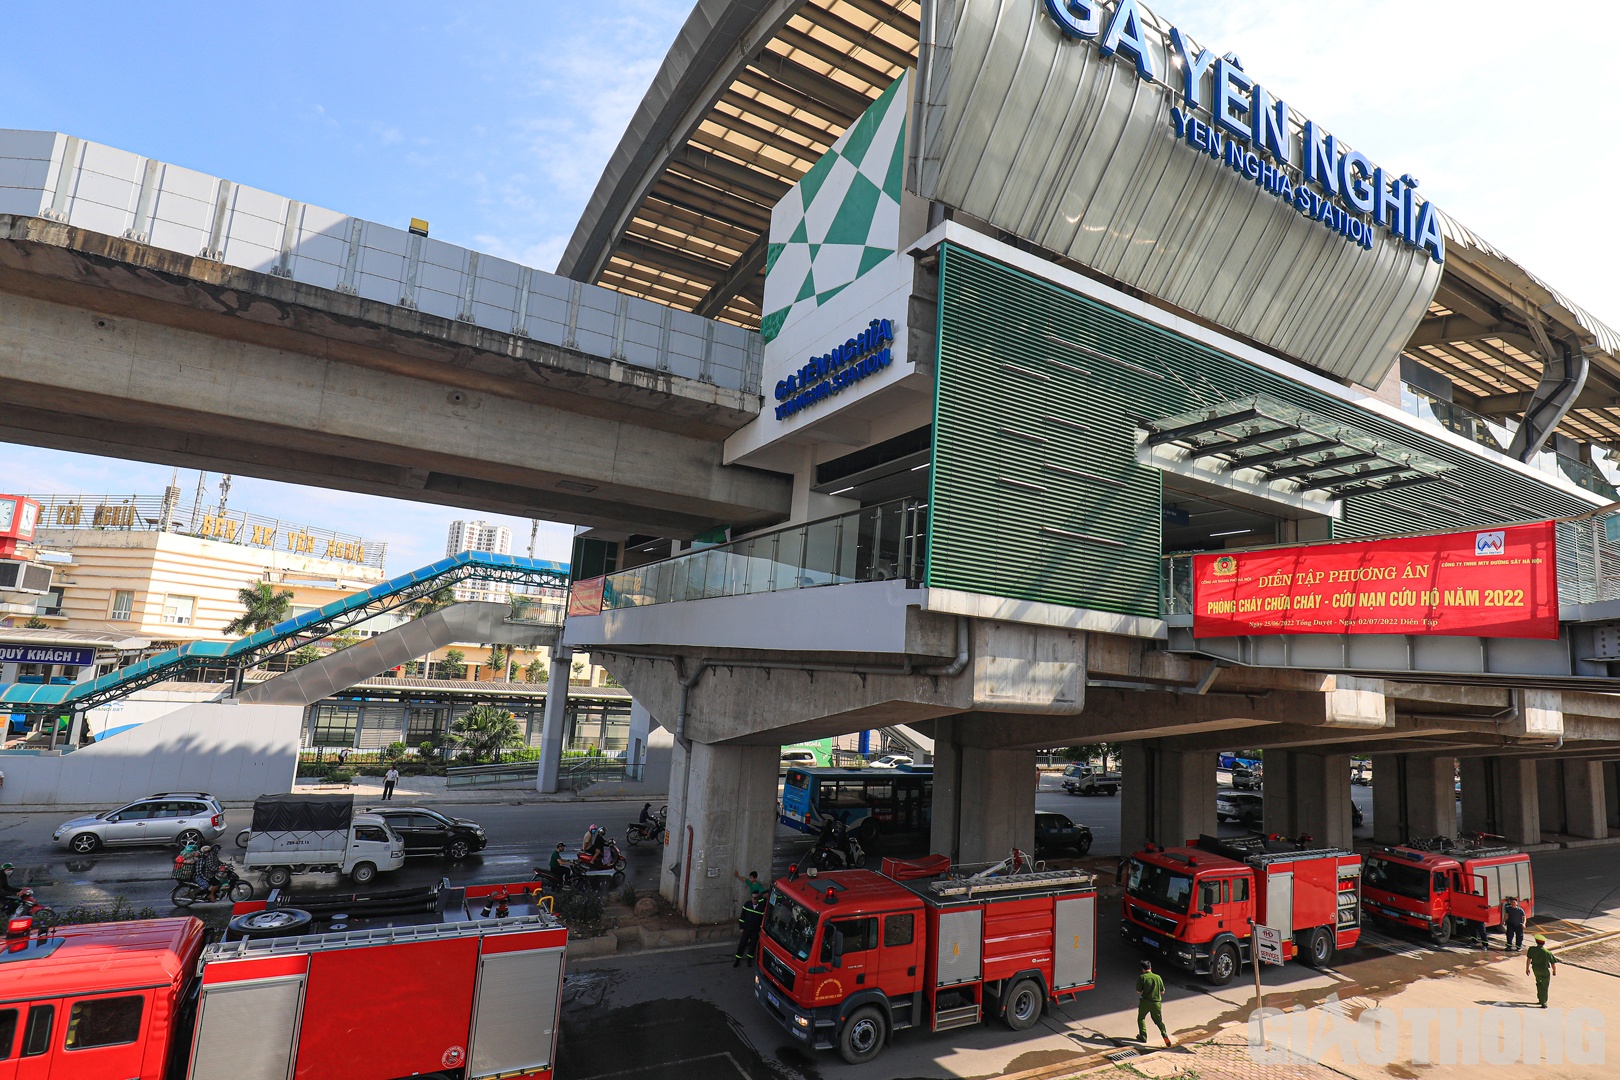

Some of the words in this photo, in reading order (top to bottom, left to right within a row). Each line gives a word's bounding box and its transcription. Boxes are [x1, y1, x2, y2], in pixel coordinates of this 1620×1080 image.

[1044, 0, 1156, 83] GA
[1169, 26, 1291, 165] YÊN
[1303, 119, 1444, 264] NGHĨA
[1170, 105, 1221, 160] YEN
[1224, 140, 1294, 204] NGHIA
[1293, 184, 1374, 251] STATION
[831, 347, 891, 392] STATION
[775, 374, 798, 400] GA
[56, 499, 83, 525] YÊN
[251, 525, 274, 546] XE
[287, 529, 317, 553] YÊN
[1258, 568, 1292, 588] DIỄN
[1296, 568, 1325, 588] TẬP
[1328, 566, 1397, 583] PHƯƠNG
[1402, 561, 1430, 579] ÁN
[1207, 597, 1236, 615] PHÒNG
[1238, 596, 1263, 613] CHÁY
[1264, 593, 1291, 611] CHỮA
[1293, 591, 1323, 610] CHÁY
[1332, 589, 1356, 608] CỨU
[1359, 591, 1386, 610] NẠN
[1389, 587, 1416, 607] CỨU
[1420, 587, 1440, 610] HỘ
[1444, 587, 1480, 607] NĂM
[1484, 589, 1524, 607] 2022
[1339, 618, 1356, 627] Ngày
[1358, 618, 1399, 626] 02/07/2022
[0, 647, 24, 660] QUÝ
[27, 649, 72, 662] KHÁCH
[75, 652, 81, 662] !
[1073, 935, 1080, 949] 2
[1261, 950, 1280, 960] SERVICES
